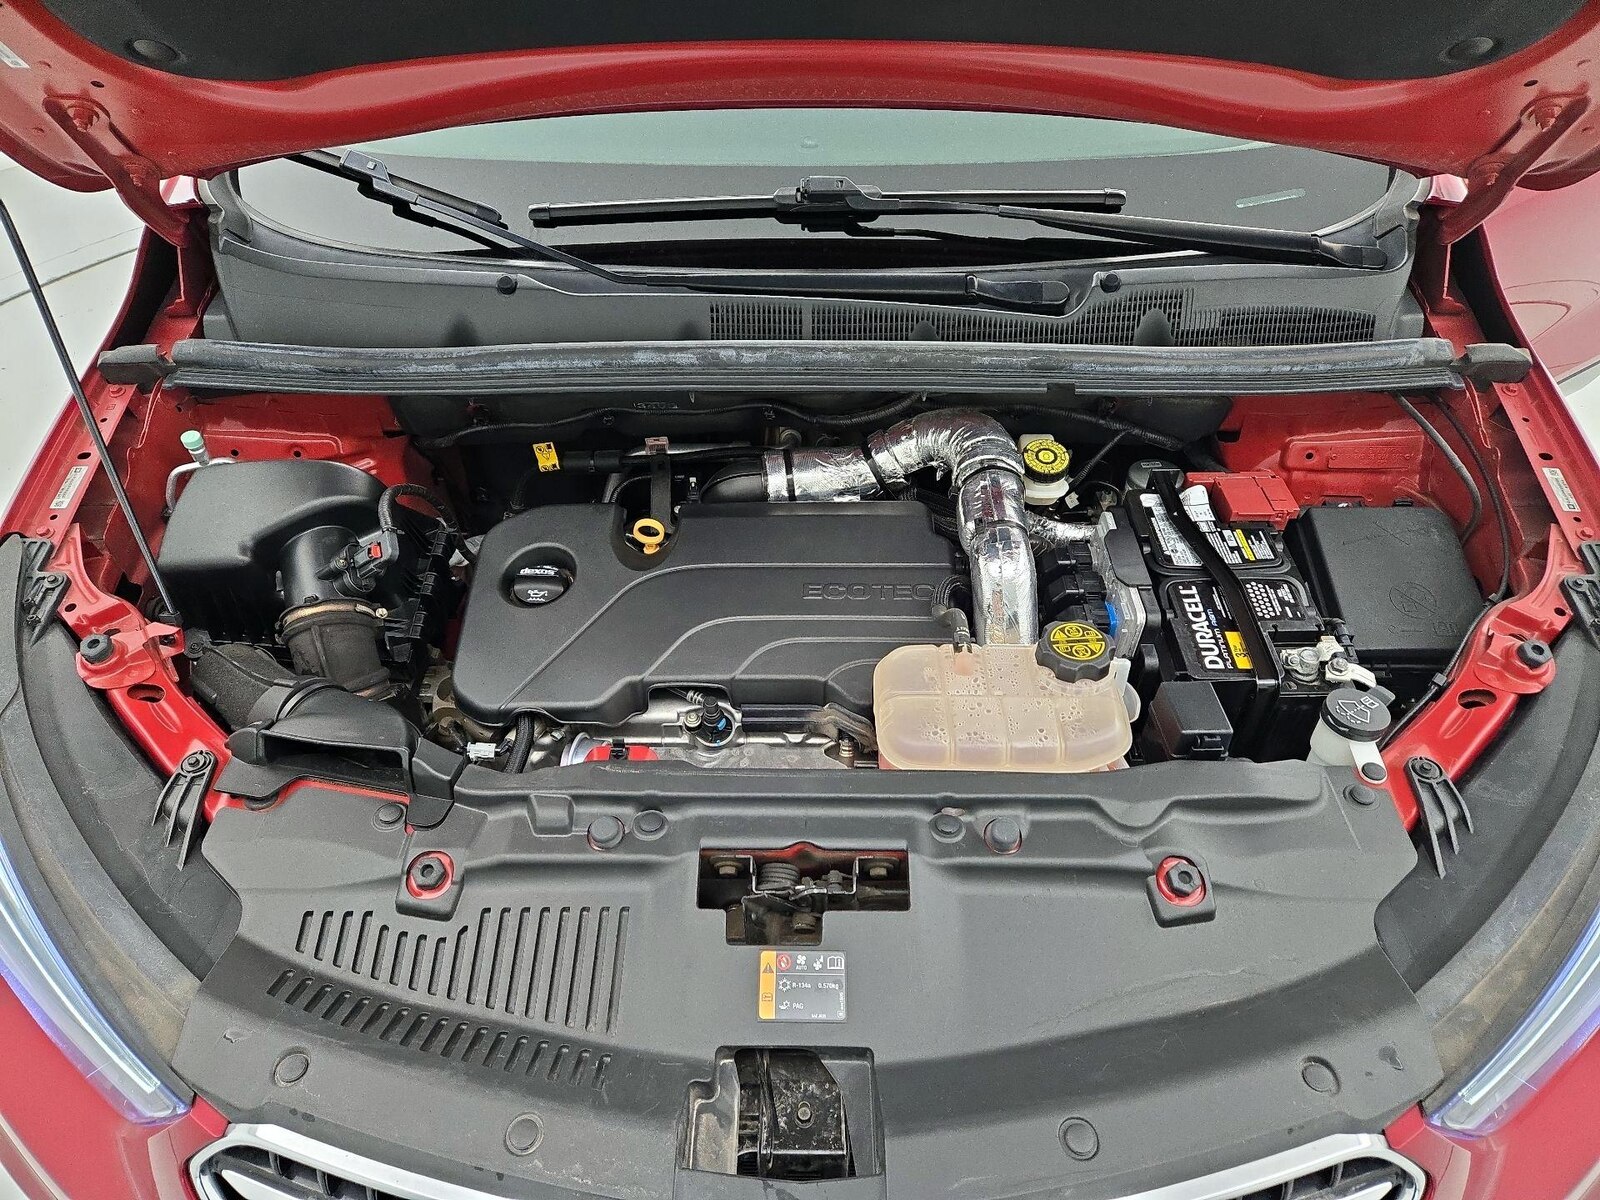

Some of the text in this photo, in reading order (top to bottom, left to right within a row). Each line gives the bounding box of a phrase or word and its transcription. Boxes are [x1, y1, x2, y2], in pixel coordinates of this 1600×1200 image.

[520, 567, 555, 575] dexos
[803, 583, 935, 600] ECOTEC
[1179, 585, 1225, 669] DURACELL
[792, 1002, 804, 1010] PAG
